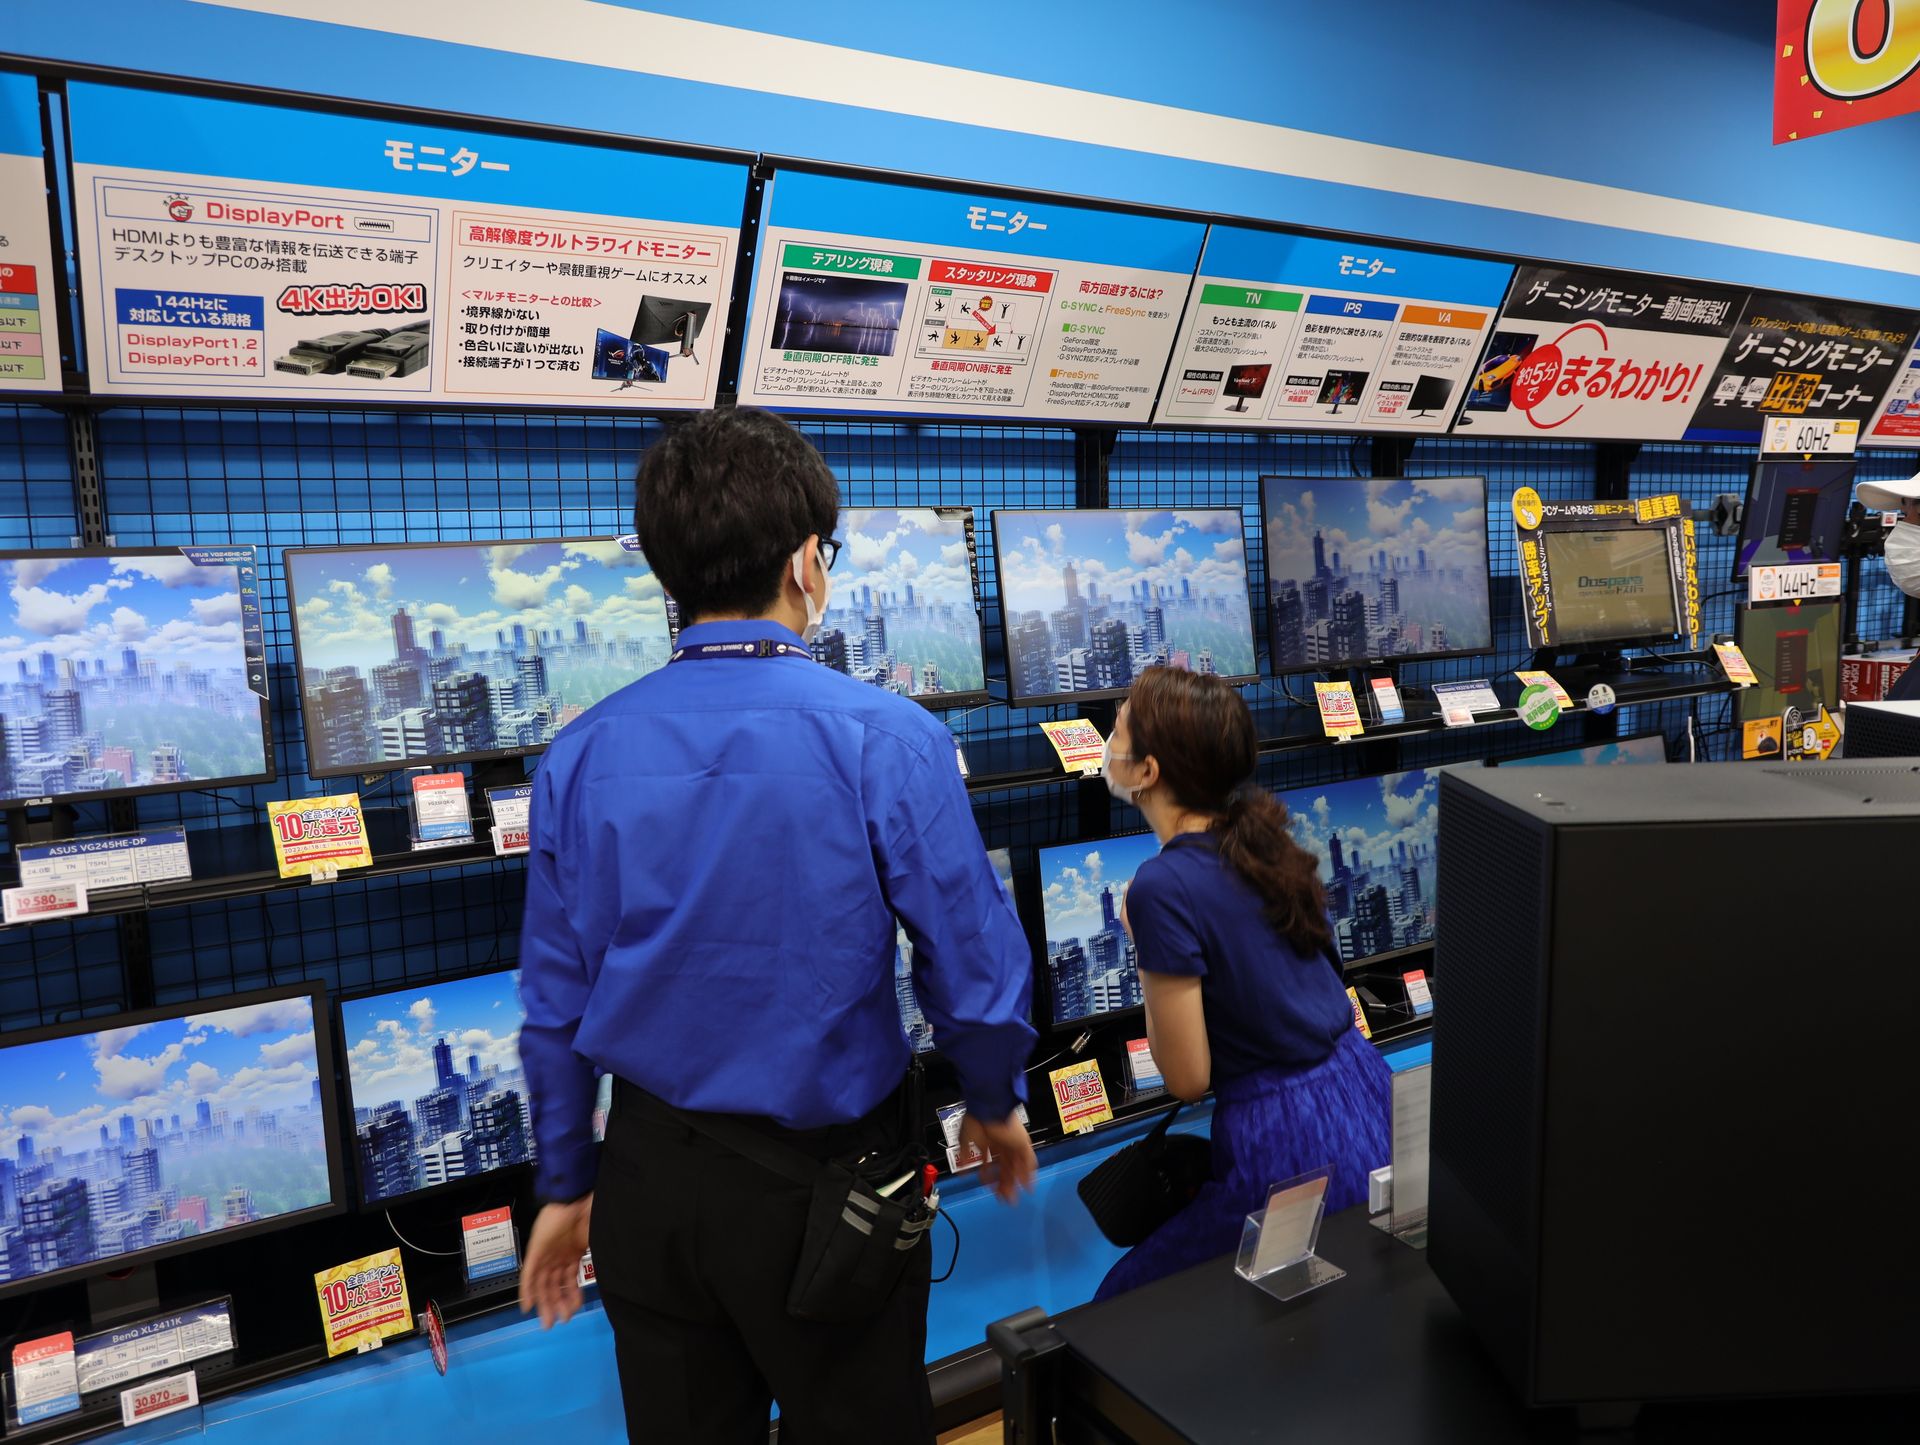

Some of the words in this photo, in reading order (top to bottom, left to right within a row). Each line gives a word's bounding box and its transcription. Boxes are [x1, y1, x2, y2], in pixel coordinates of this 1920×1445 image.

[384, 138, 510, 177] モニター
[206, 201, 344, 230] DisplayPort
[966, 206, 1048, 235] モニター
[112, 227, 419, 265] HDMIよりも豊富な情報を伝送できる端子
[469, 226, 711, 260] 高解像度ウルトラワイドモニター
[114, 245, 308, 274] デスクトップPCのみ搭載
[812, 252, 894, 273] テアリング現象
[1338, 255, 1396, 279] モニター
[463, 256, 708, 286] クリエイターや景観重視ゲームにオススメ
[945, 266, 1037, 288] スタッタリング現象
[1079, 280, 1163, 300] 両方回避するには?
[1245, 292, 1262, 305] TN
[155, 295, 228, 311] 144Hzに
[278, 285, 425, 315] 4K出力OK!
[1060, 301, 1097, 313] G-SYNC
[1105, 305, 1147, 318] FreeSync
[1343, 302, 1363, 314] IPS
[1525, 281, 1731, 325] ゲーミングモニター動画解説!
[129, 308, 252, 327] 対応している規格
[1212, 316, 1277, 329] もっとも主流のパネル
[1438, 312, 1452, 324] VA
[1069, 324, 1106, 335] G-SYNC
[1305, 323, 1384, 339] 色彩を鮮やかに映せるパネル
[127, 333, 258, 351] DisplayPort1.2
[128, 351, 258, 368] DisplayPort1.4
[783, 351, 879, 367] 垂直同期OFF時に発生
[1734, 332, 1894, 374] ゲーミングモニター
[764, 367, 850, 378] ビデオカードのフレームレートが
[931, 361, 1013, 375] 垂直同期ON時に発生
[1057, 369, 1100, 380] FreeSync
[1518, 360, 1558, 387] 約5分
[911, 376, 987, 386] ビデオカードのフレームレートが
[1556, 355, 1704, 404] まるわかり!
[761, 384, 877, 396] フレームの一部が割り込んで表示される現象
[908, 391, 1011, 402] 表示待ち時間が発生しカクついて見える現象
[1527, 387, 1539, 402] で
[1796, 426, 1830, 451] 60Hz
[1578, 576, 1645, 589] Dospara
[1778, 572, 1816, 597] 144Hz
[1850, 664, 1860, 696] DISPLAY
[24, 797, 53, 806] ASUS
[304, 808, 357, 820] 全品ポイント
[275, 815, 361, 841] 10%還元
[49, 845, 77, 856] ASUS
[80, 837, 147, 852] VG245HE-DP
[347, 1264, 400, 1287] 全品ポイント
[322, 1275, 401, 1315] 10%還元
[112, 1328, 139, 1343] BenQ
[141, 1316, 182, 1335] XL2411K
